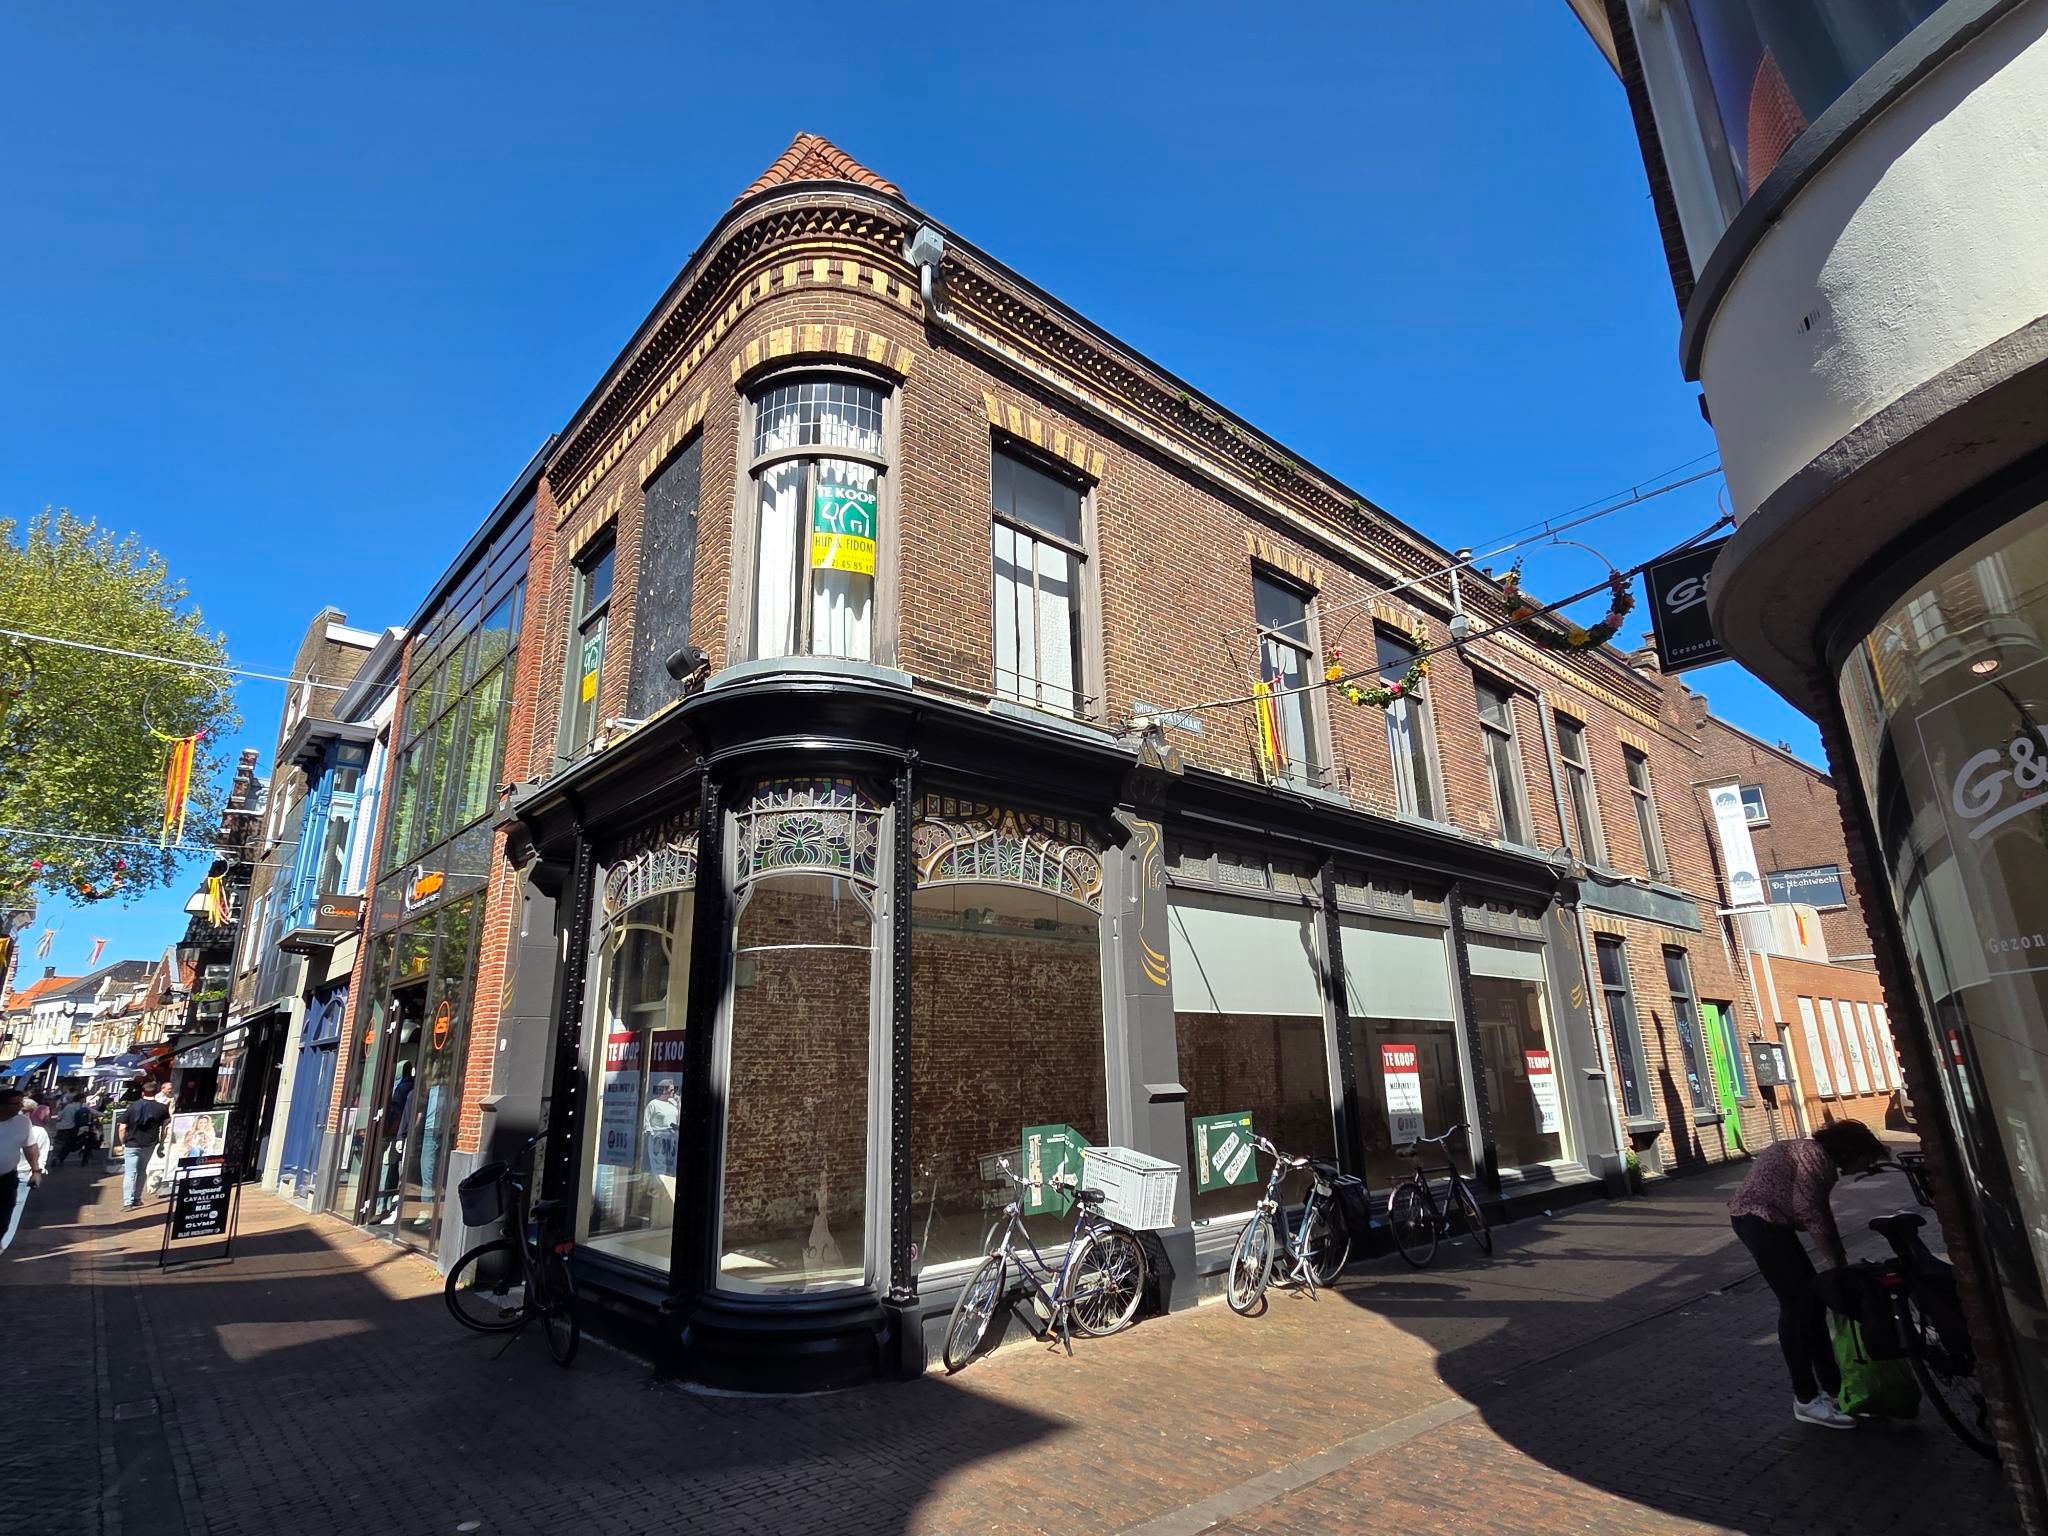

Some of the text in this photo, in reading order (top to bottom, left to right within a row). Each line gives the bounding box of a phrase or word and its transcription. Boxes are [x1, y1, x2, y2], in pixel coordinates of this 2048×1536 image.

[817, 485, 876, 504] TE KOOP
[846, 538, 873, 554] FIDOM
[1672, 638, 1720, 656] Gezondh
[1953, 725, 2048, 818] G&
[1772, 881, 1785, 890] De
[1988, 933, 2048, 954] Gezon
[608, 1042, 640, 1061] TE KOOP
[653, 1041, 685, 1062] TE KOO
[1384, 1052, 1415, 1067] TE KOOP
[183, 1193, 225, 1203] CAVALLARO
[188, 1186, 223, 1195] Vanguard
[185, 1220, 216, 1229] OLYMP
